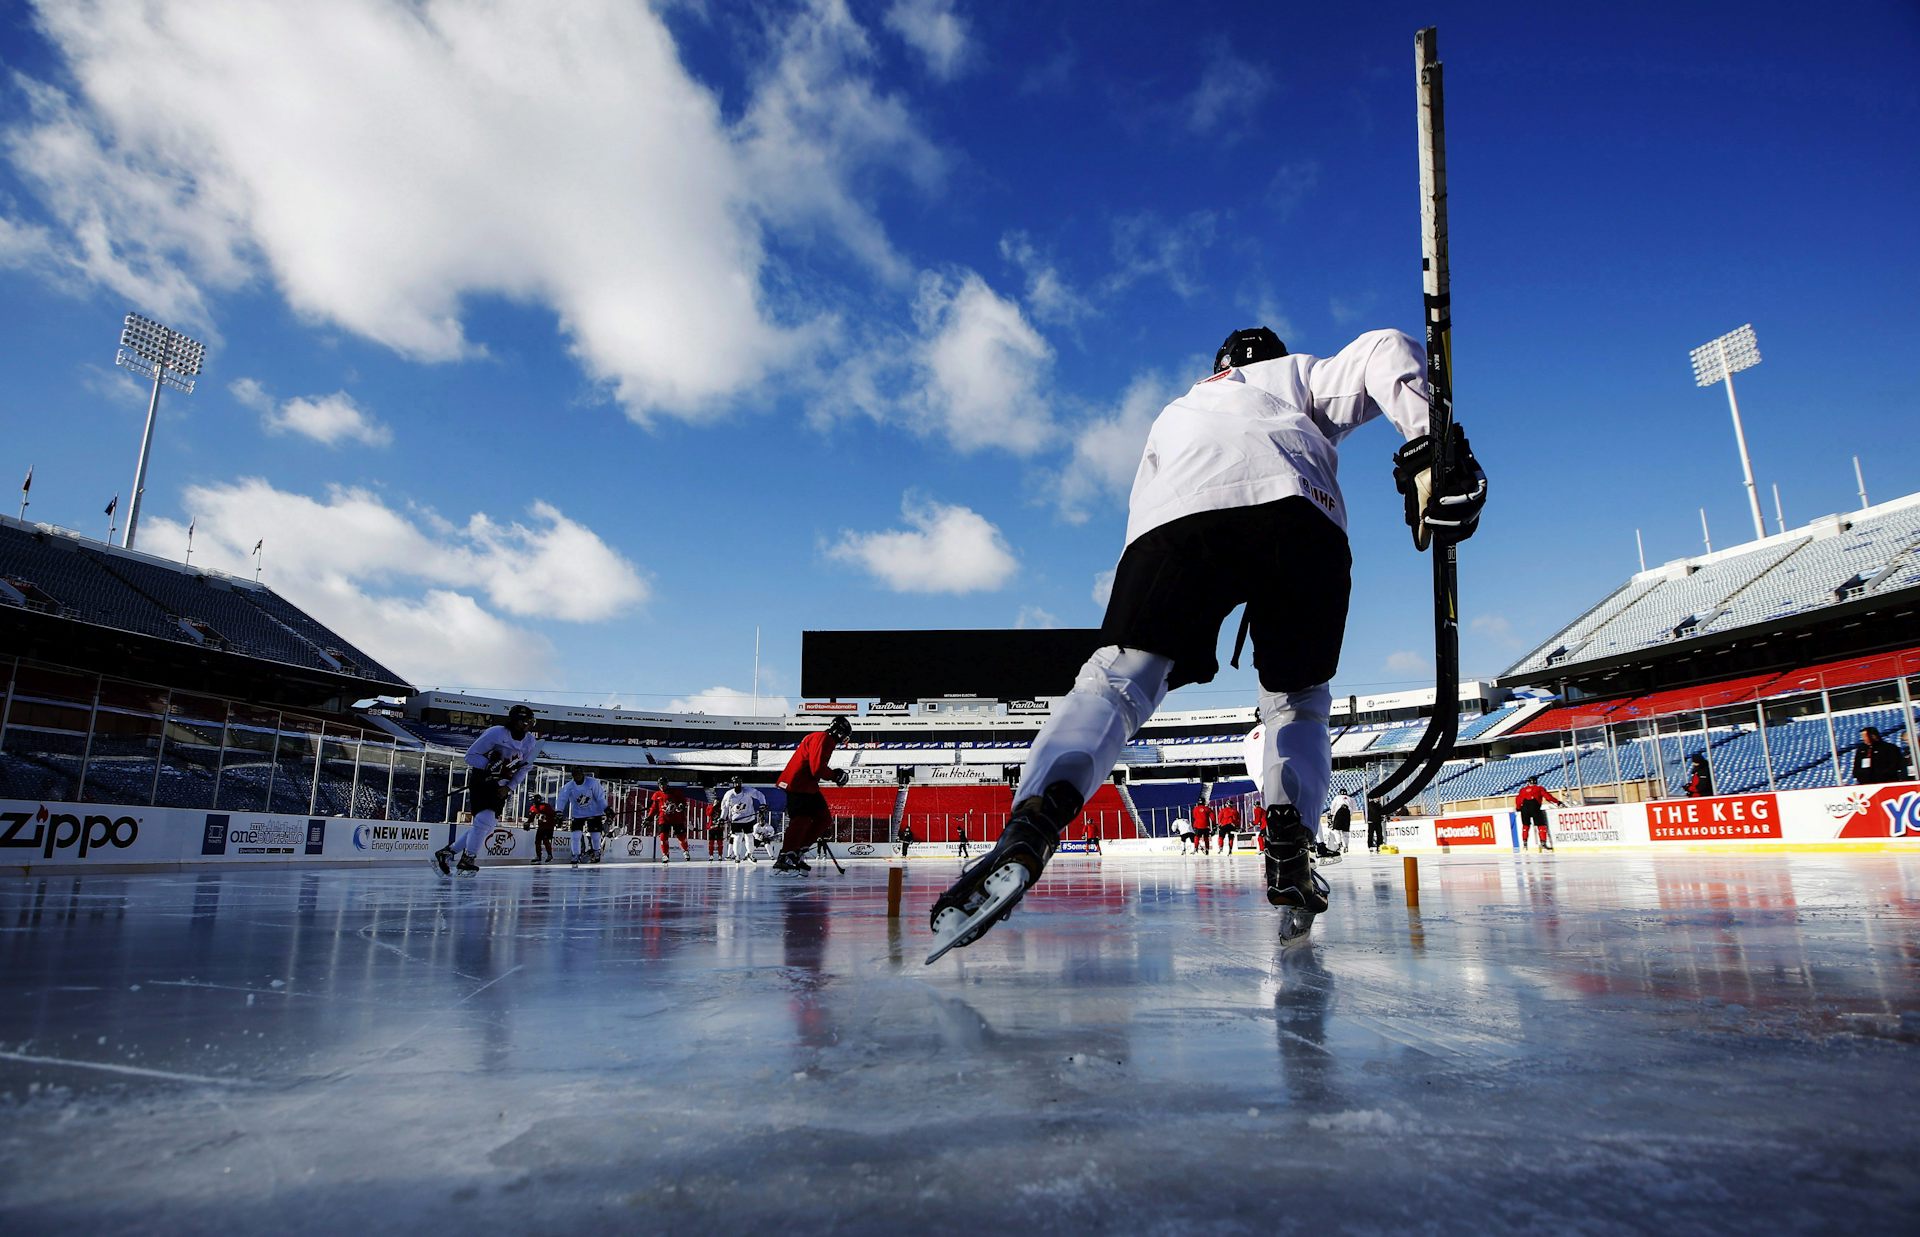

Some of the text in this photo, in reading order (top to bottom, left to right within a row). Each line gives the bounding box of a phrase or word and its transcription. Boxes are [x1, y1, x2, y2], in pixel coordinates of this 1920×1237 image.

[1246, 347, 1253, 359] 2
[870, 701, 908, 711] FanDuel
[1011, 701, 1047, 710] FanDuel
[645, 738, 658, 746] 242
[931, 767, 985, 778] Tim Hortons
[1652, 799, 1769, 824] THE KEG
[373, 826, 430, 842] NEW WAVE
[1350, 829, 1366, 839] ISSOT
[1395, 826, 1419, 837] TISSOT
[1436, 825, 1480, 839] McDonald's
[371, 840, 429, 853] Energy Corporation
[487, 847, 512, 857] HOCKEY
